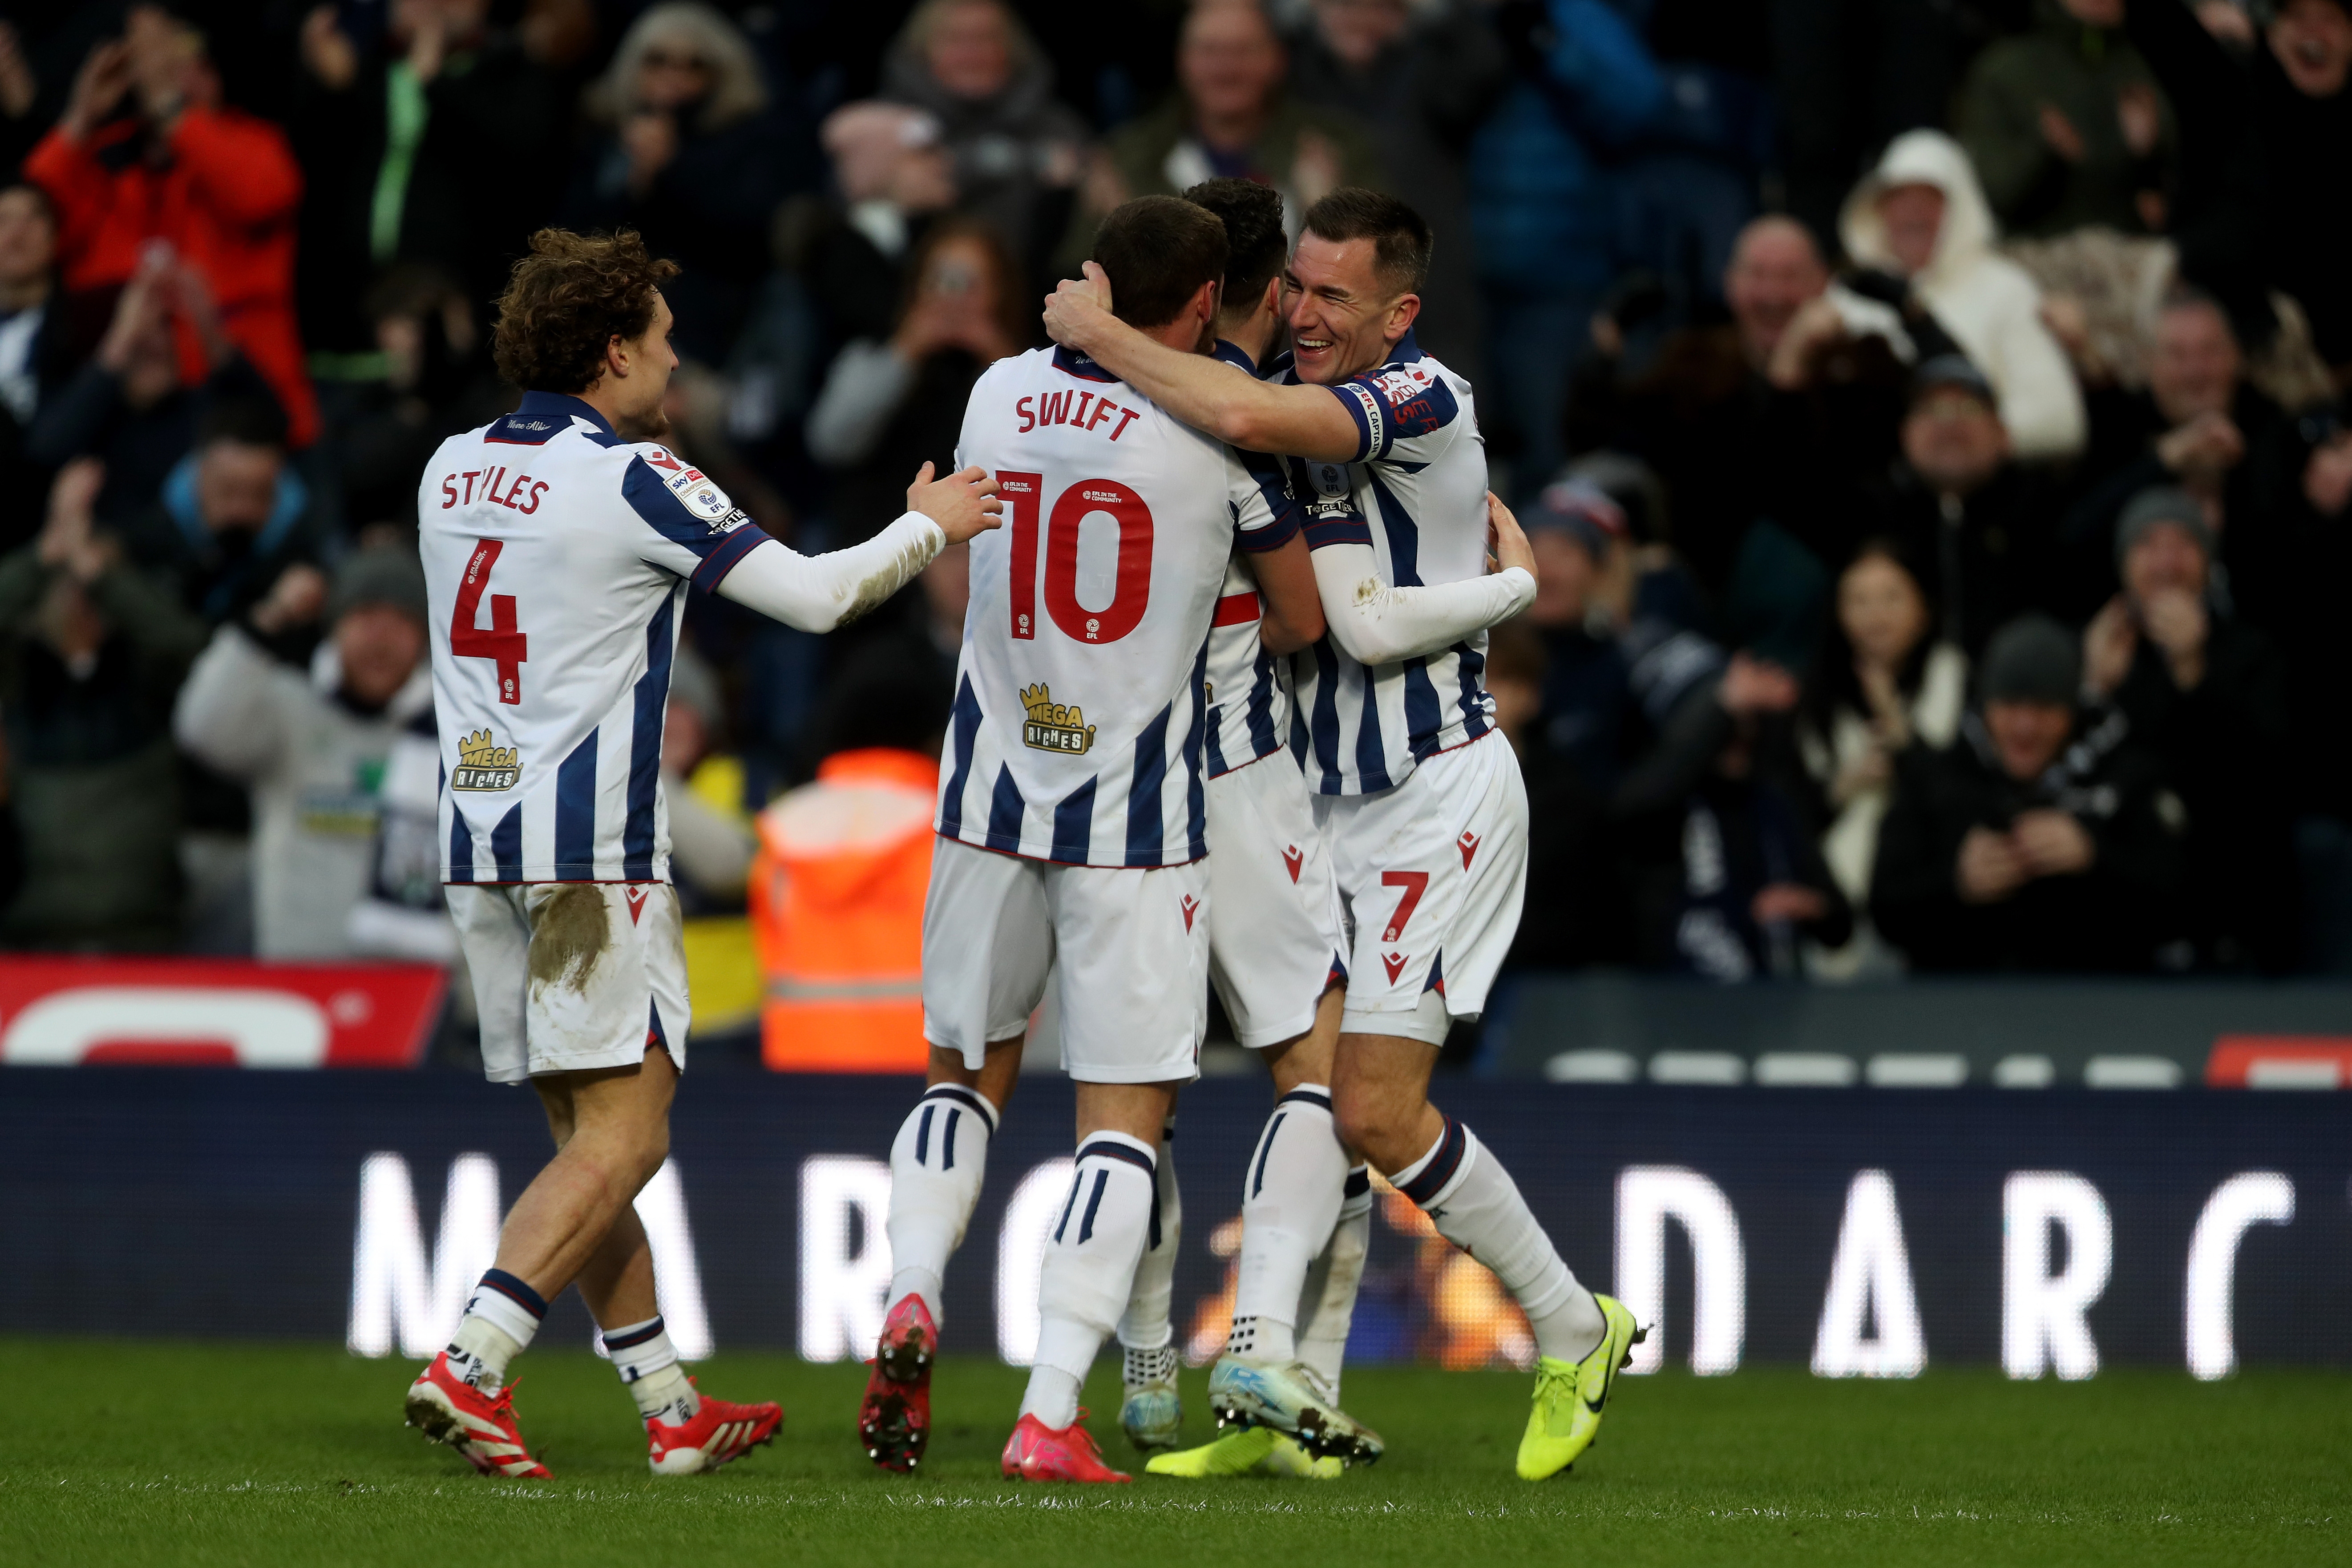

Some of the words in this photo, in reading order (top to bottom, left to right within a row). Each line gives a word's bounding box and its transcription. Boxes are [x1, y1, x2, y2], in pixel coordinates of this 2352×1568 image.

[1016, 389, 1140, 441] SWIFT
[1361, 393, 1374, 410] EFL
[1370, 412, 1380, 453] CAPTAIN
[442, 465, 549, 515] STYLES
[672, 477, 688, 489] sky
[687, 470, 701, 479] bet
[710, 503, 725, 513] EFL
[995, 470, 1154, 645] 10
[450, 538, 527, 705] 4
[1028, 703, 1084, 728] MEGA
[1028, 727, 1081, 749] RICHES
[457, 771, 513, 788] RICHES
[461, 748, 517, 767] MEGA
[1381, 871, 1429, 942] 7
[1614, 1165, 2352, 1381] DARC
